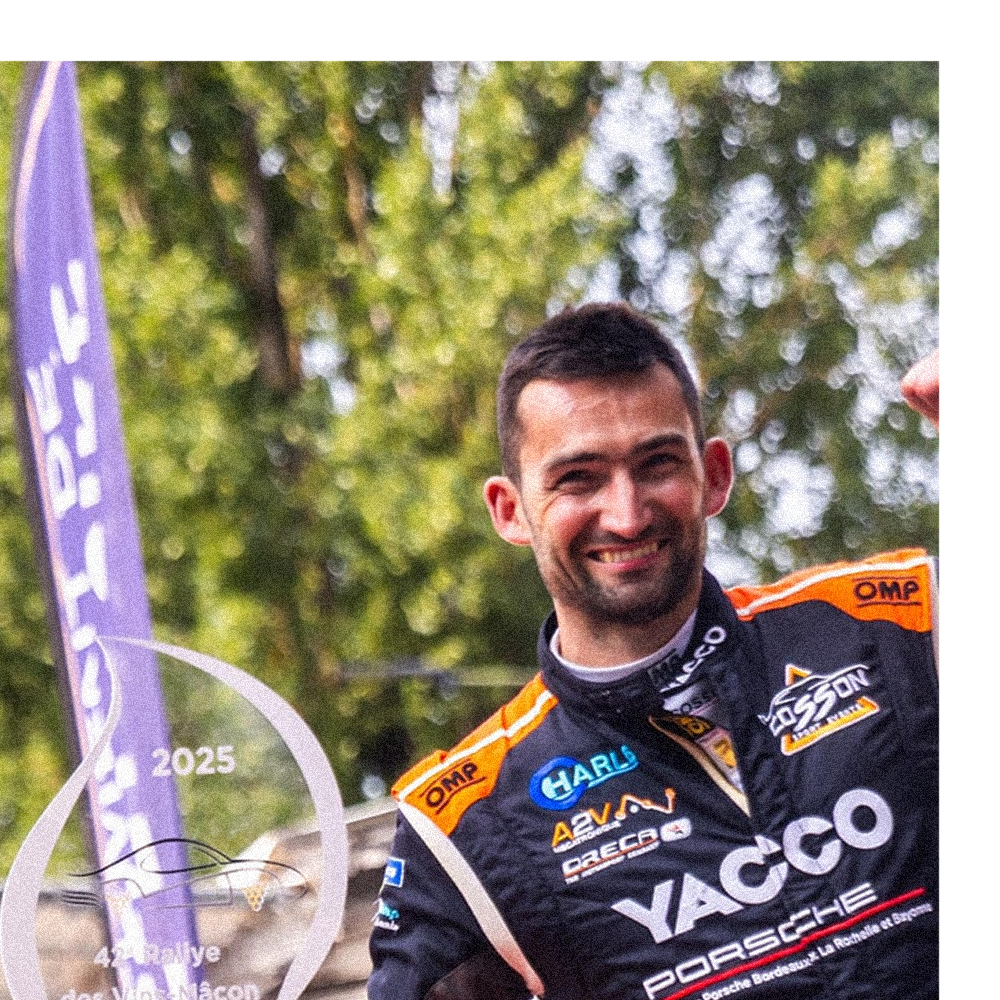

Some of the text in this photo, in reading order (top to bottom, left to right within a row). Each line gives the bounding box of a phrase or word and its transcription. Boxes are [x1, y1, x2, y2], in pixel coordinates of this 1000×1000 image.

[854, 580, 920, 601] OMP
[768, 669, 871, 737] COSSON
[151, 745, 236, 778] 2025
[425, 761, 479, 808] OMP
[561, 827, 659, 876] ORECA
[610, 787, 895, 945] YACCO
[144, 941, 221, 968] Rallye
[818, 942, 836, 961] La
[835, 923, 880, 950] Rochelle
[880, 915, 893, 931] et
